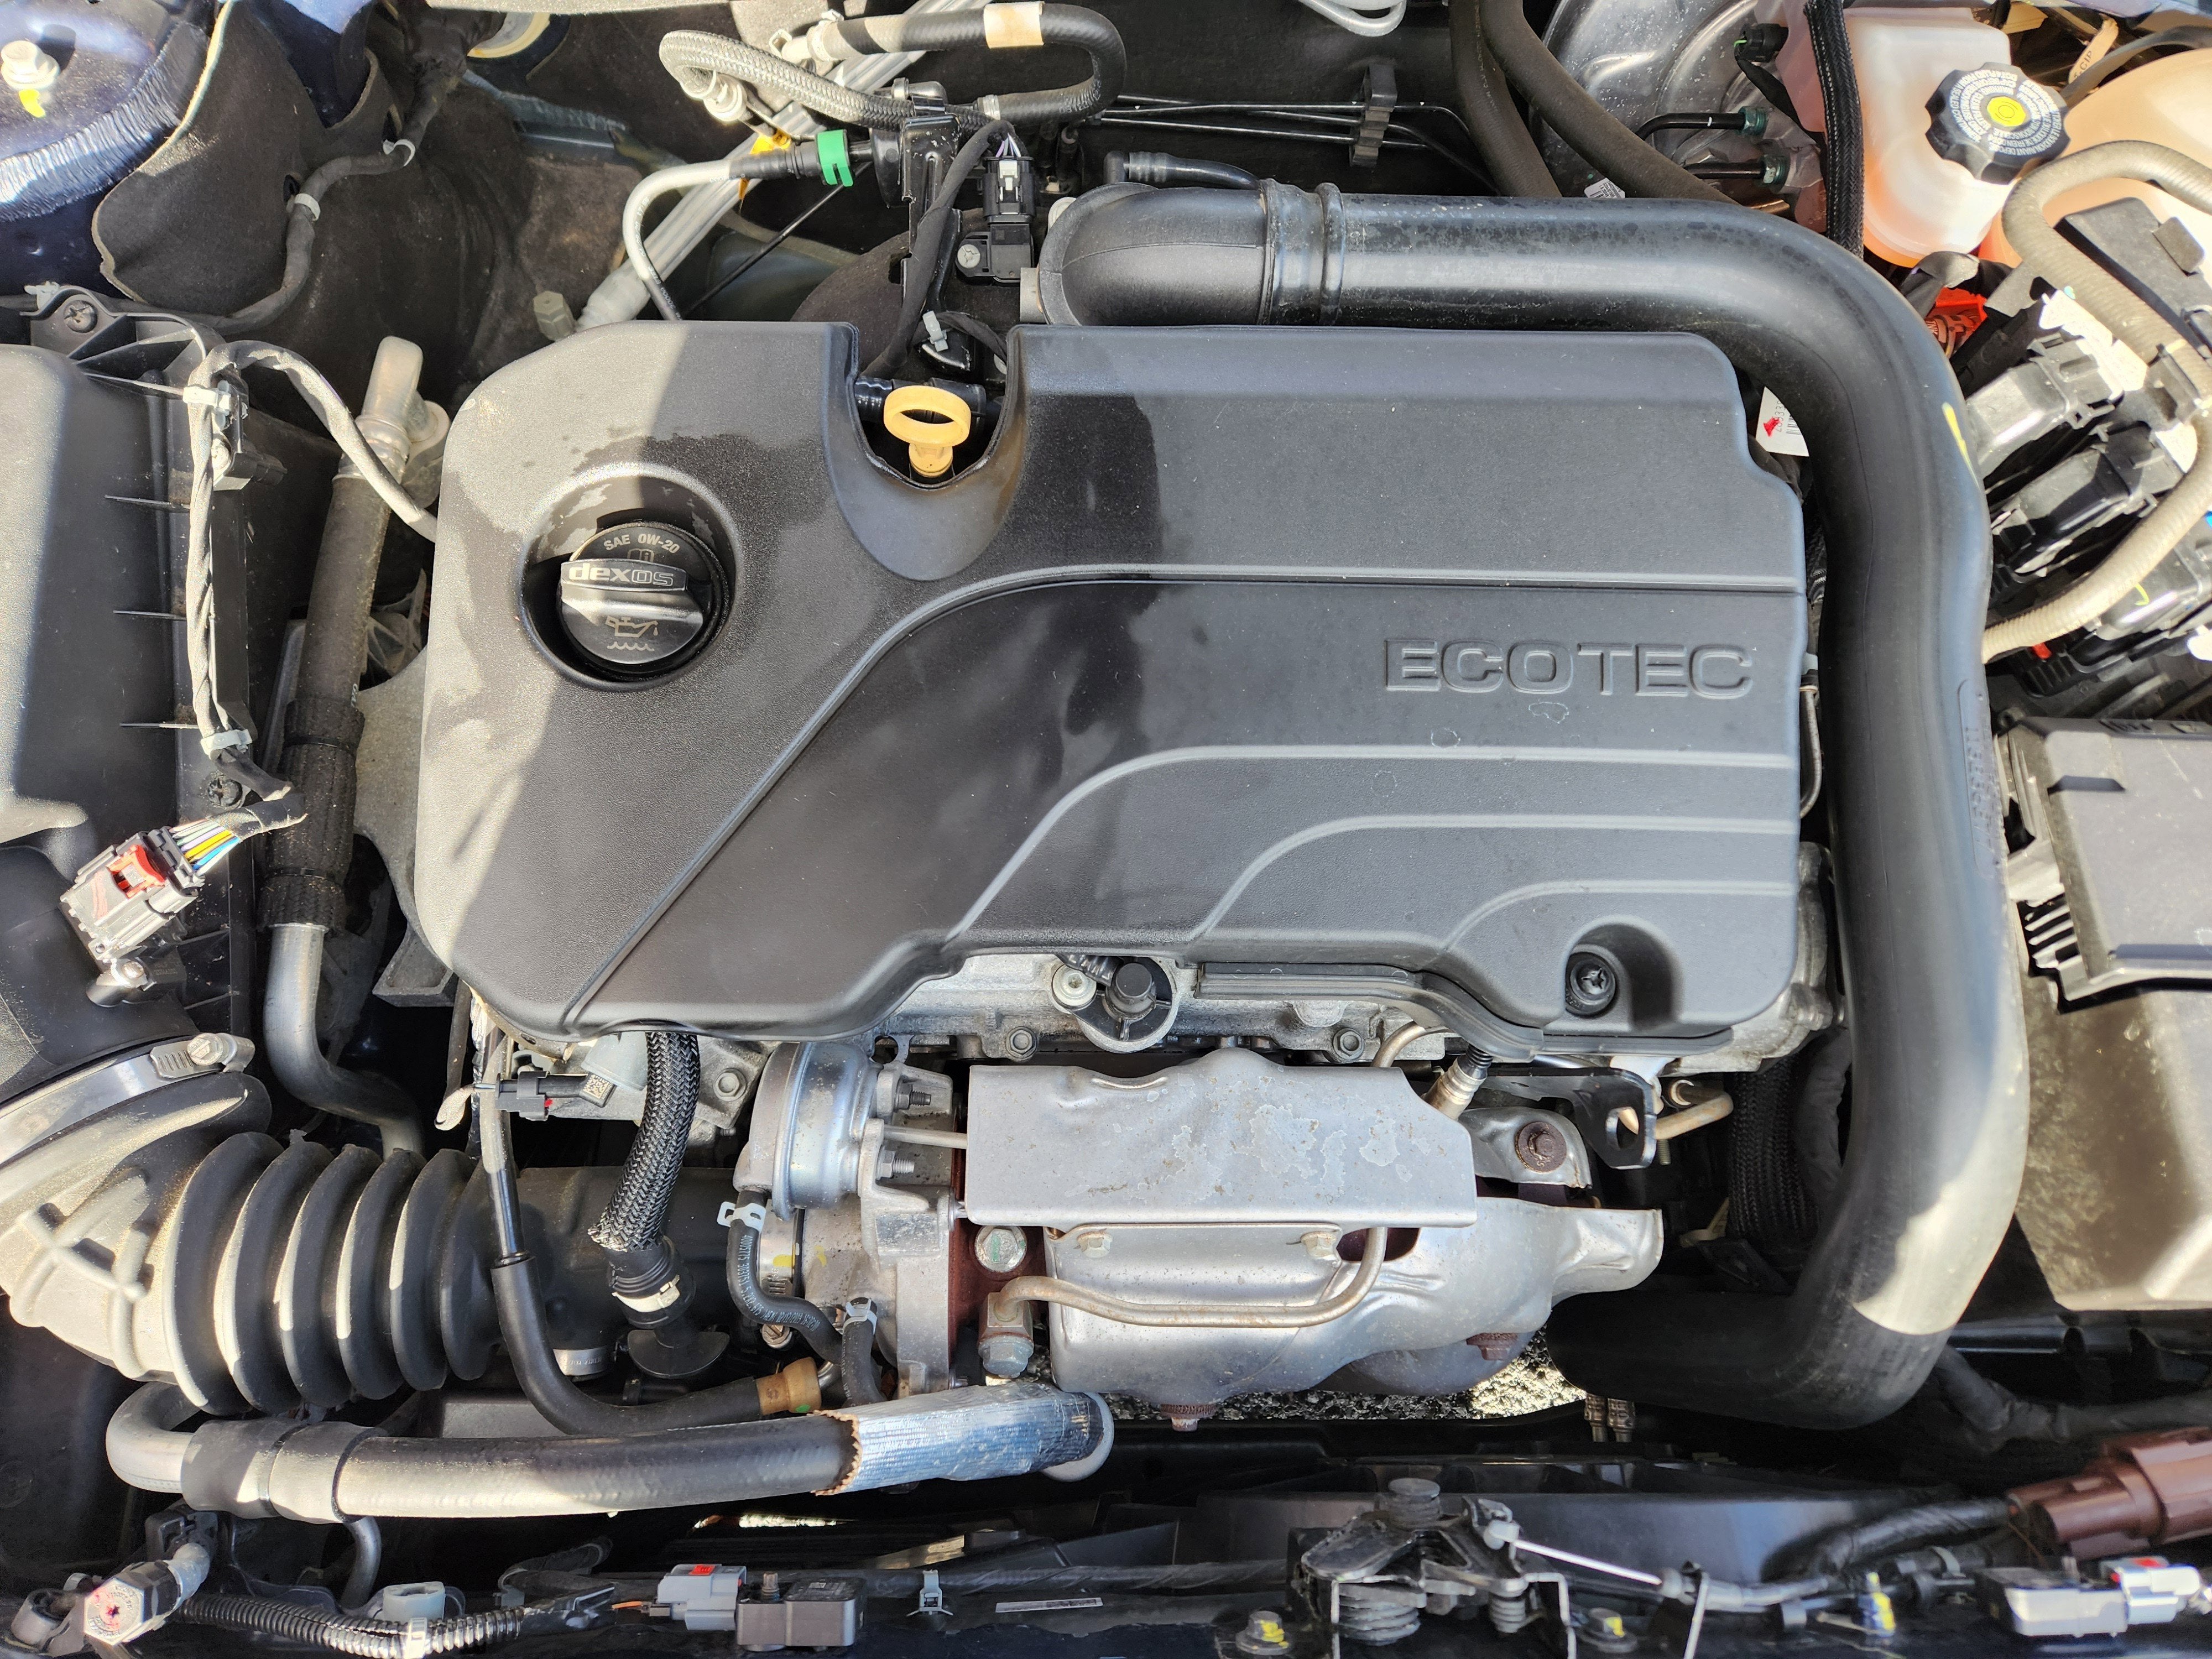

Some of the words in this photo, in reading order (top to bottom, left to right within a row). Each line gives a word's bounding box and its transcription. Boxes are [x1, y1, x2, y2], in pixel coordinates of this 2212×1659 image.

[1957, 72, 1977, 87] FROM
[1973, 69, 1996, 79] FLUID
[1949, 86, 1962, 109] SEALED
[2029, 127, 2049, 144] LIQUIDE
[2050, 128, 2060, 137] LE
[2006, 139, 2026, 148] FREIN
[2015, 146, 2037, 155] AVANT
[2022, 138, 2034, 147] DE
[2033, 134, 2057, 152] BOUCHON
[604, 534, 631, 551] SAE
[638, 533, 680, 554] 0W-20
[568, 563, 674, 587] dexos
[1384, 639, 1754, 700] ECOTEC
